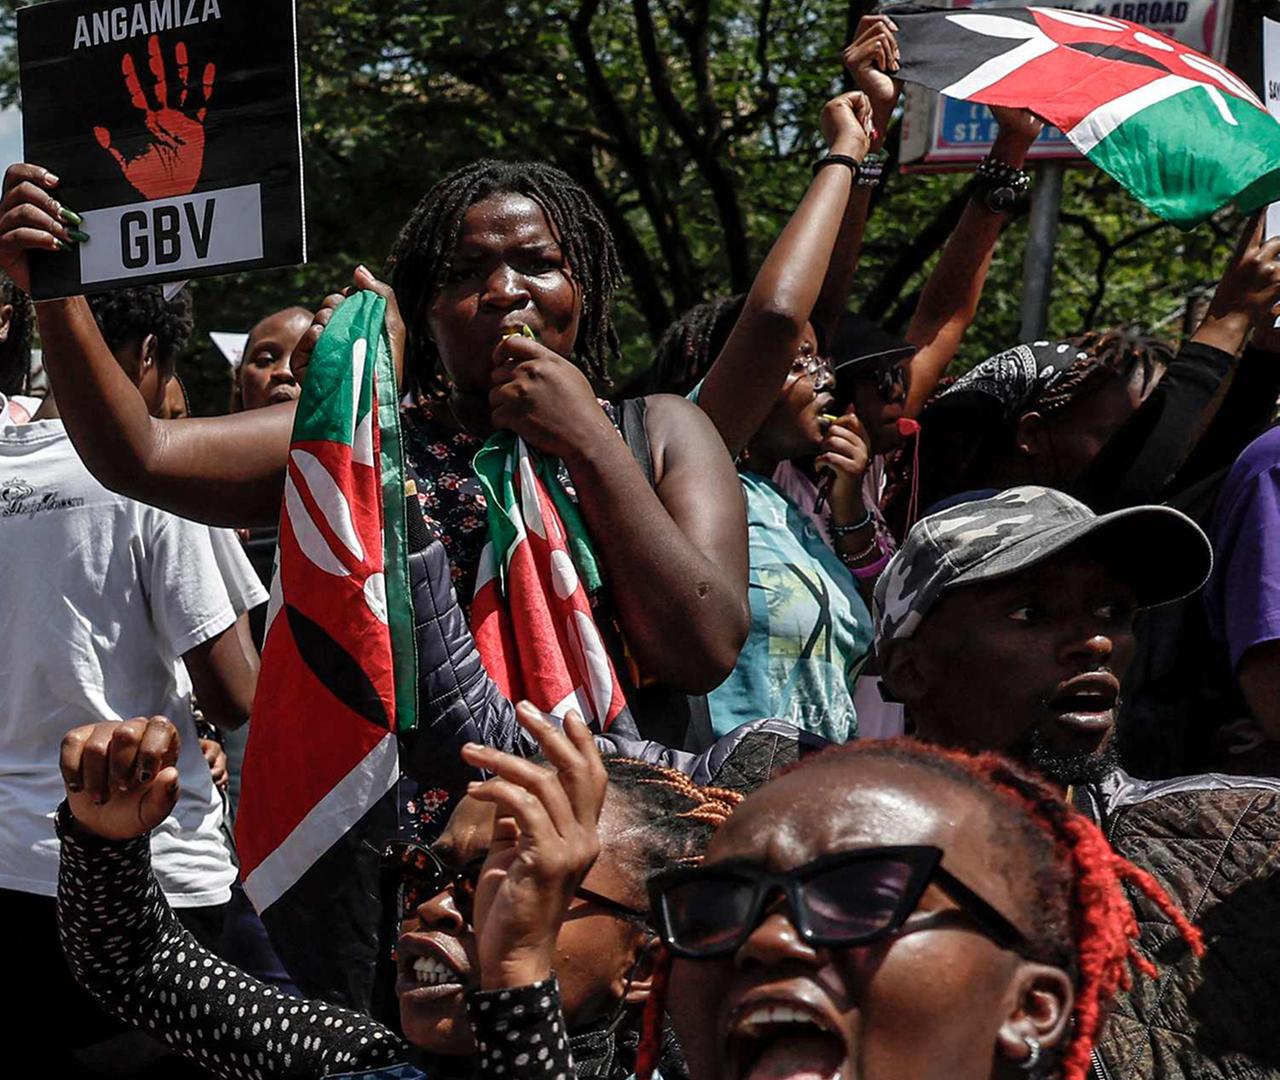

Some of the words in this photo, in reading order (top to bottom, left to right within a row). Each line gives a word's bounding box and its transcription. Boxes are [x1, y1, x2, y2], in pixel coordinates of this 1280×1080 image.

[73, 0, 222, 49] ANGAMIZA
[1109, 1, 1191, 24] ABROAD
[120, 198, 216, 270] GBV
